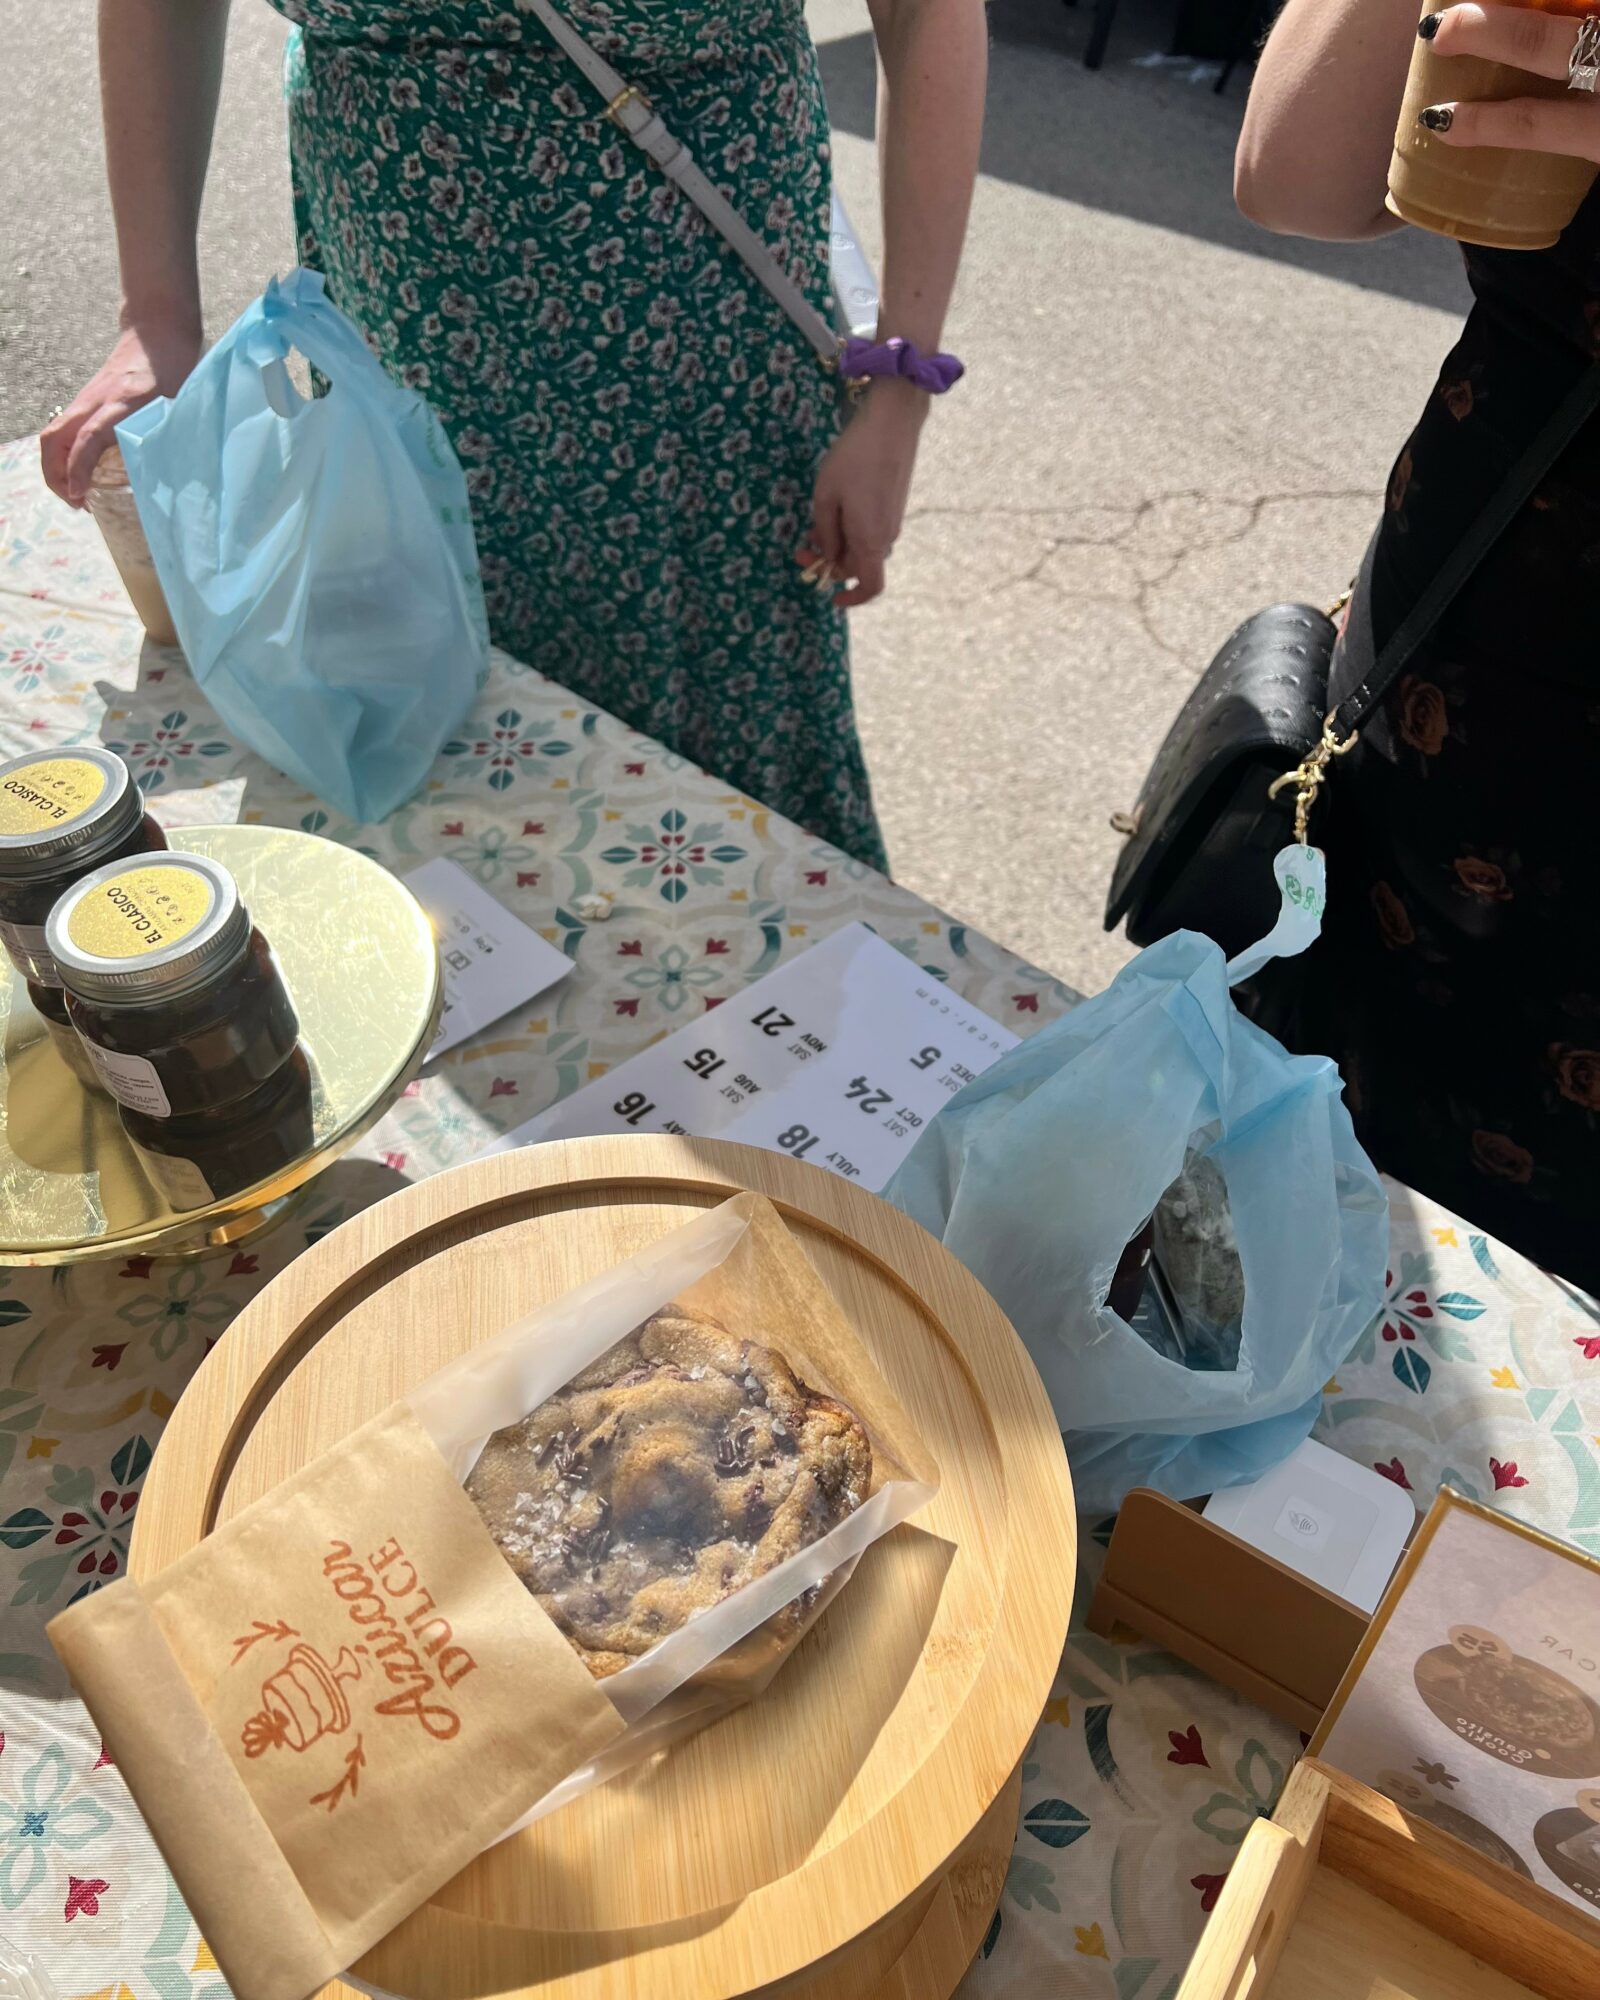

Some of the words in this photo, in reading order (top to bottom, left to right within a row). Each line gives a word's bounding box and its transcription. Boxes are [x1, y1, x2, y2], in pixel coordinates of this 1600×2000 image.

[4, 781, 54, 810] CLASICO
[50, 806, 68, 819] EL
[107, 887, 151, 931] CLASICO
[144, 929, 163, 944] EL
[750, 1006, 795, 1036] 21
[787, 1043, 812, 1060] SAT
[800, 1033, 828, 1052] NOV
[683, 1048, 726, 1080] 15
[909, 1046, 942, 1070] 5
[733, 1073, 762, 1094] AUG
[938, 1074, 962, 1092] SAT
[950, 1063, 977, 1083] DEC
[719, 1085, 745, 1104] SAT
[844, 1076, 894, 1114] 24
[613, 1091, 656, 1126] 16
[895, 1107, 924, 1128] OCT
[882, 1118, 908, 1137] SAT
[777, 1124, 820, 1159] 18
[825, 1151, 860, 1176] JULY
[369, 1537, 478, 1690] DULCE
